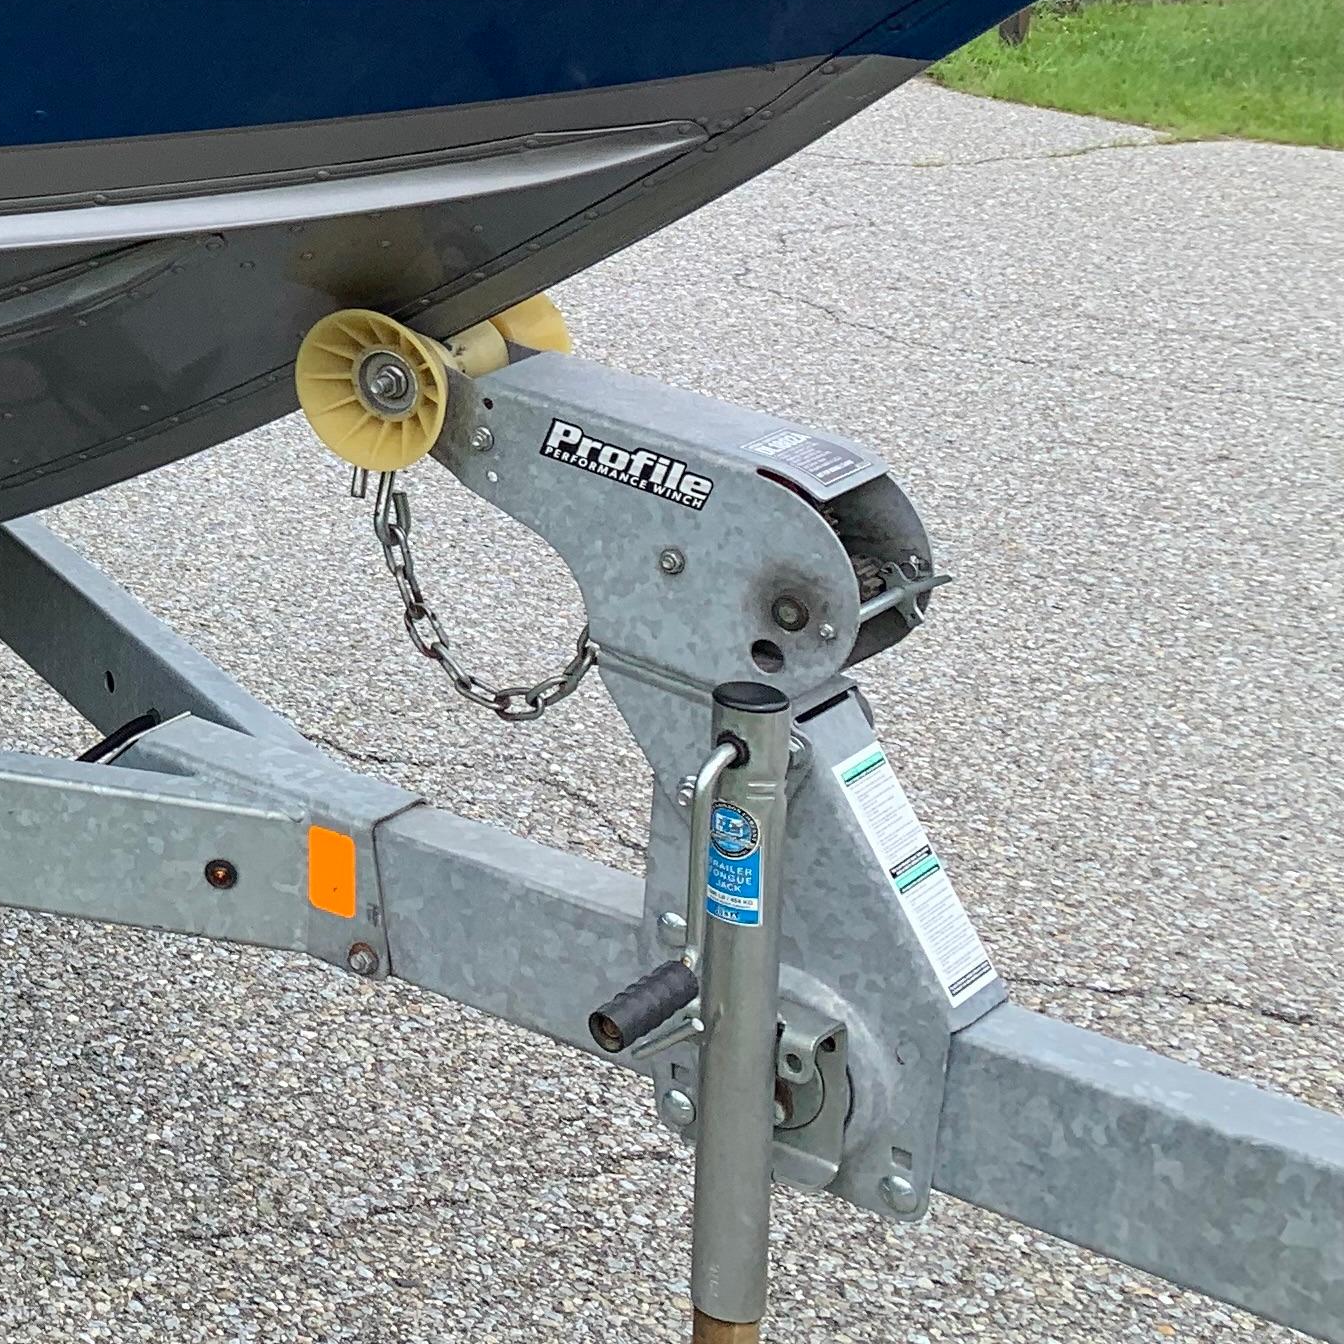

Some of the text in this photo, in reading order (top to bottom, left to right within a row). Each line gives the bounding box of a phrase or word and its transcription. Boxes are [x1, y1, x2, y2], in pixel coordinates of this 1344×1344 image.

[545, 446, 704, 510] PERFORMANCE WINCH
[547, 419, 714, 501] Profile
[715, 879, 743, 894] JACK
